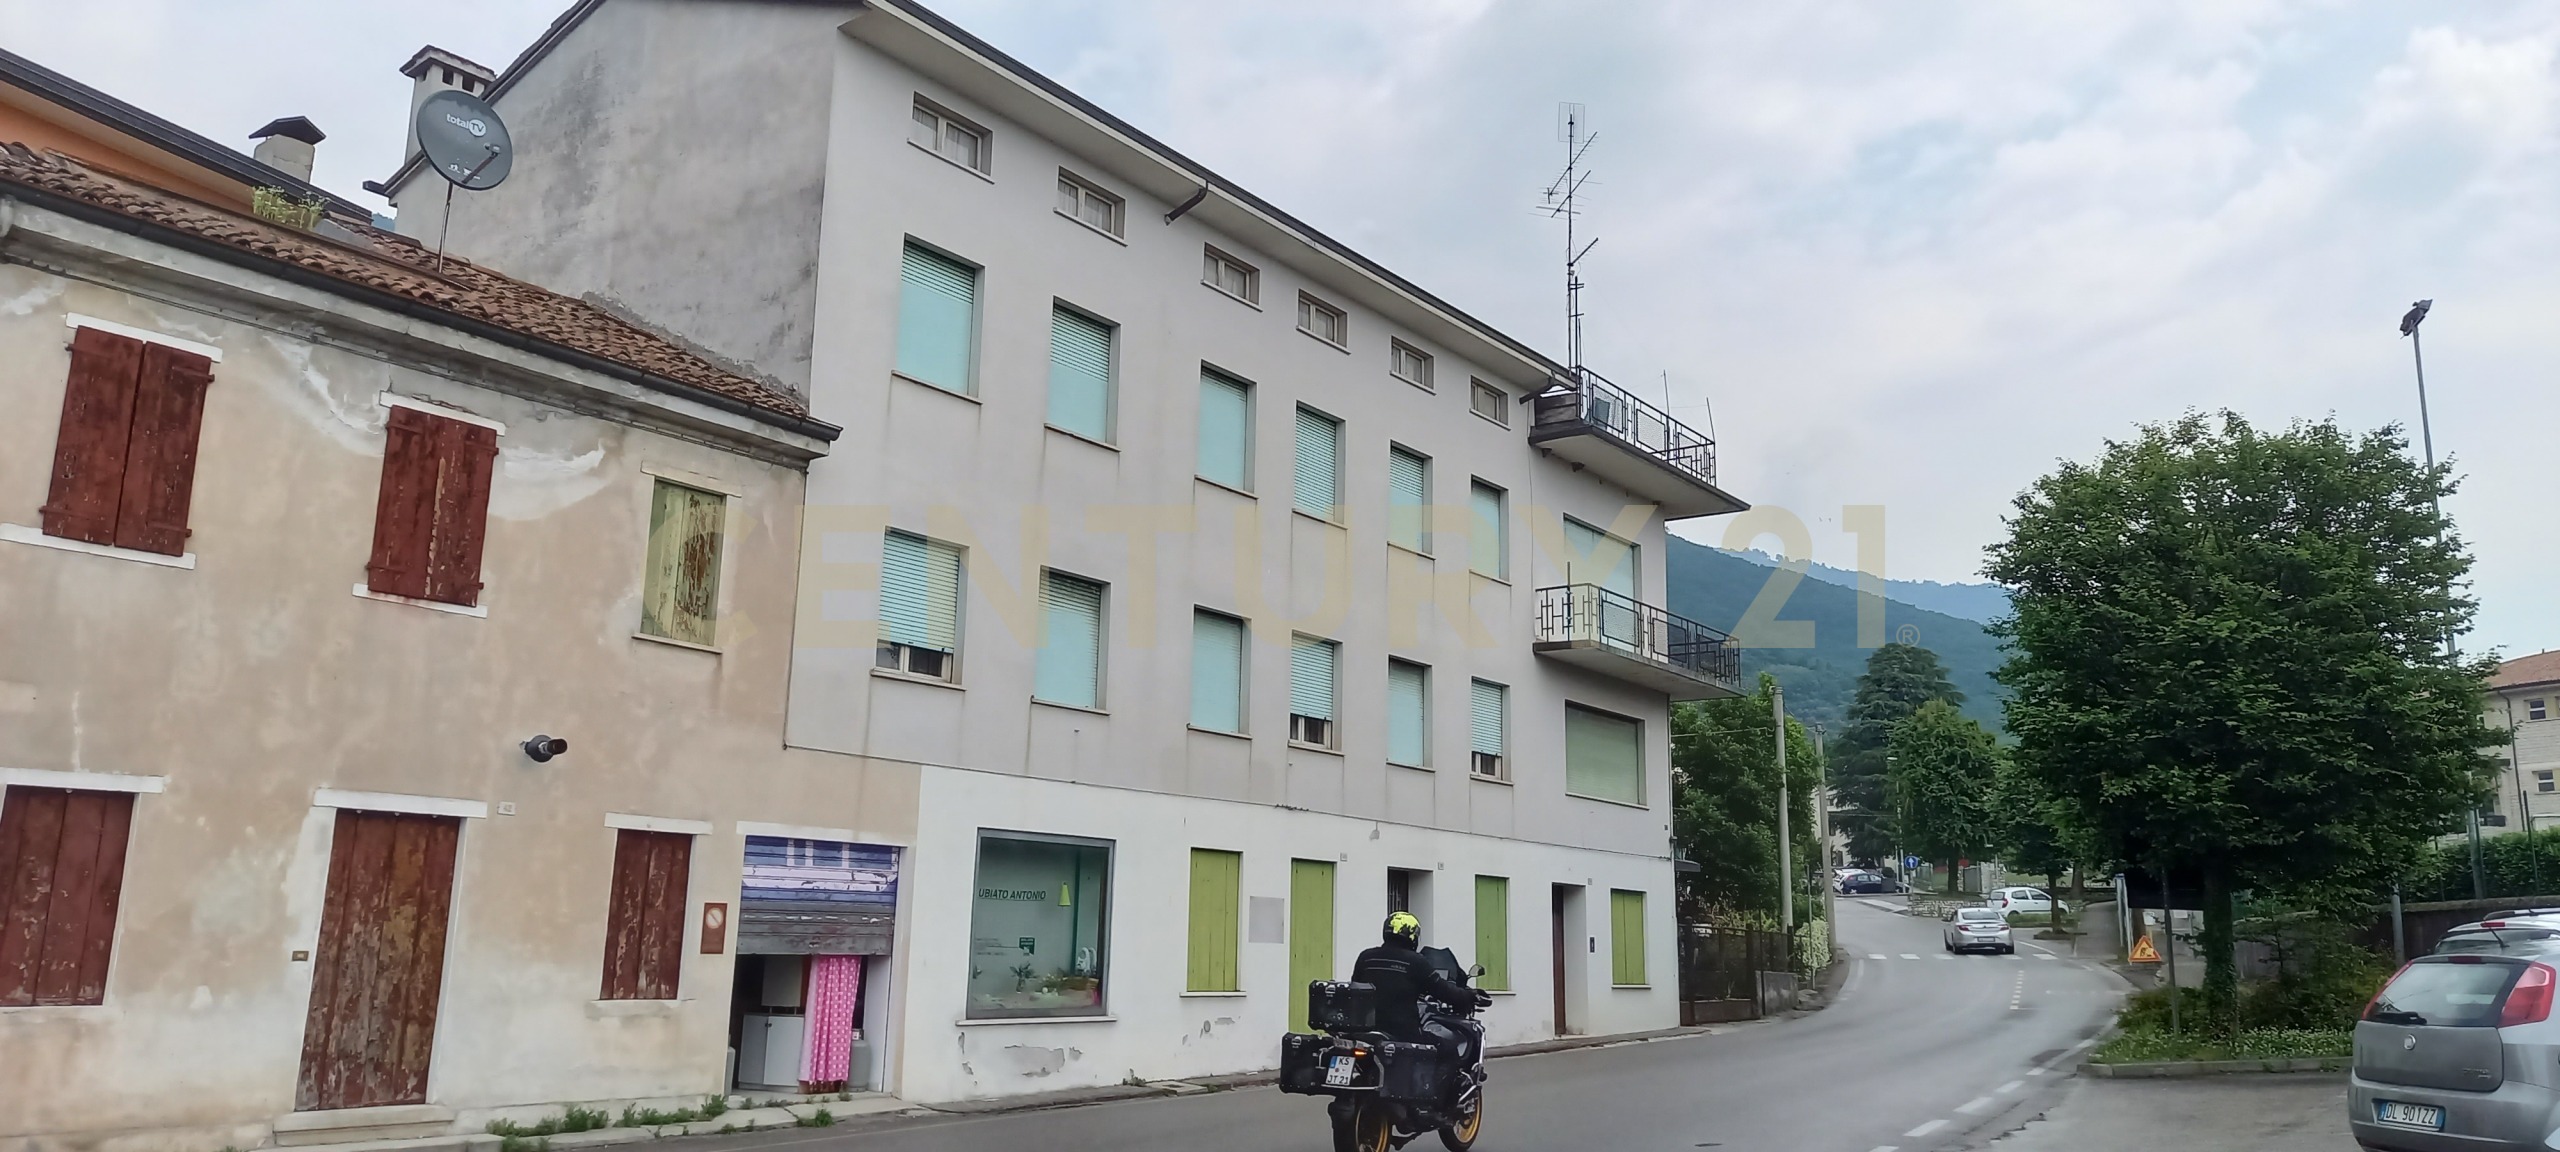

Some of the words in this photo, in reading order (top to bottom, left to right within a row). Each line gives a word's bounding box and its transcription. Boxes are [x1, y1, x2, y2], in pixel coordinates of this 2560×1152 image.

[1010, 890, 1046, 900] ANTONIO
[1339, 1057, 1350, 1066] KS
[1339, 1076, 1349, 1085] 21
[2386, 1103, 2397, 1120] DL
[2402, 1105, 2437, 1125] 901ZZ
